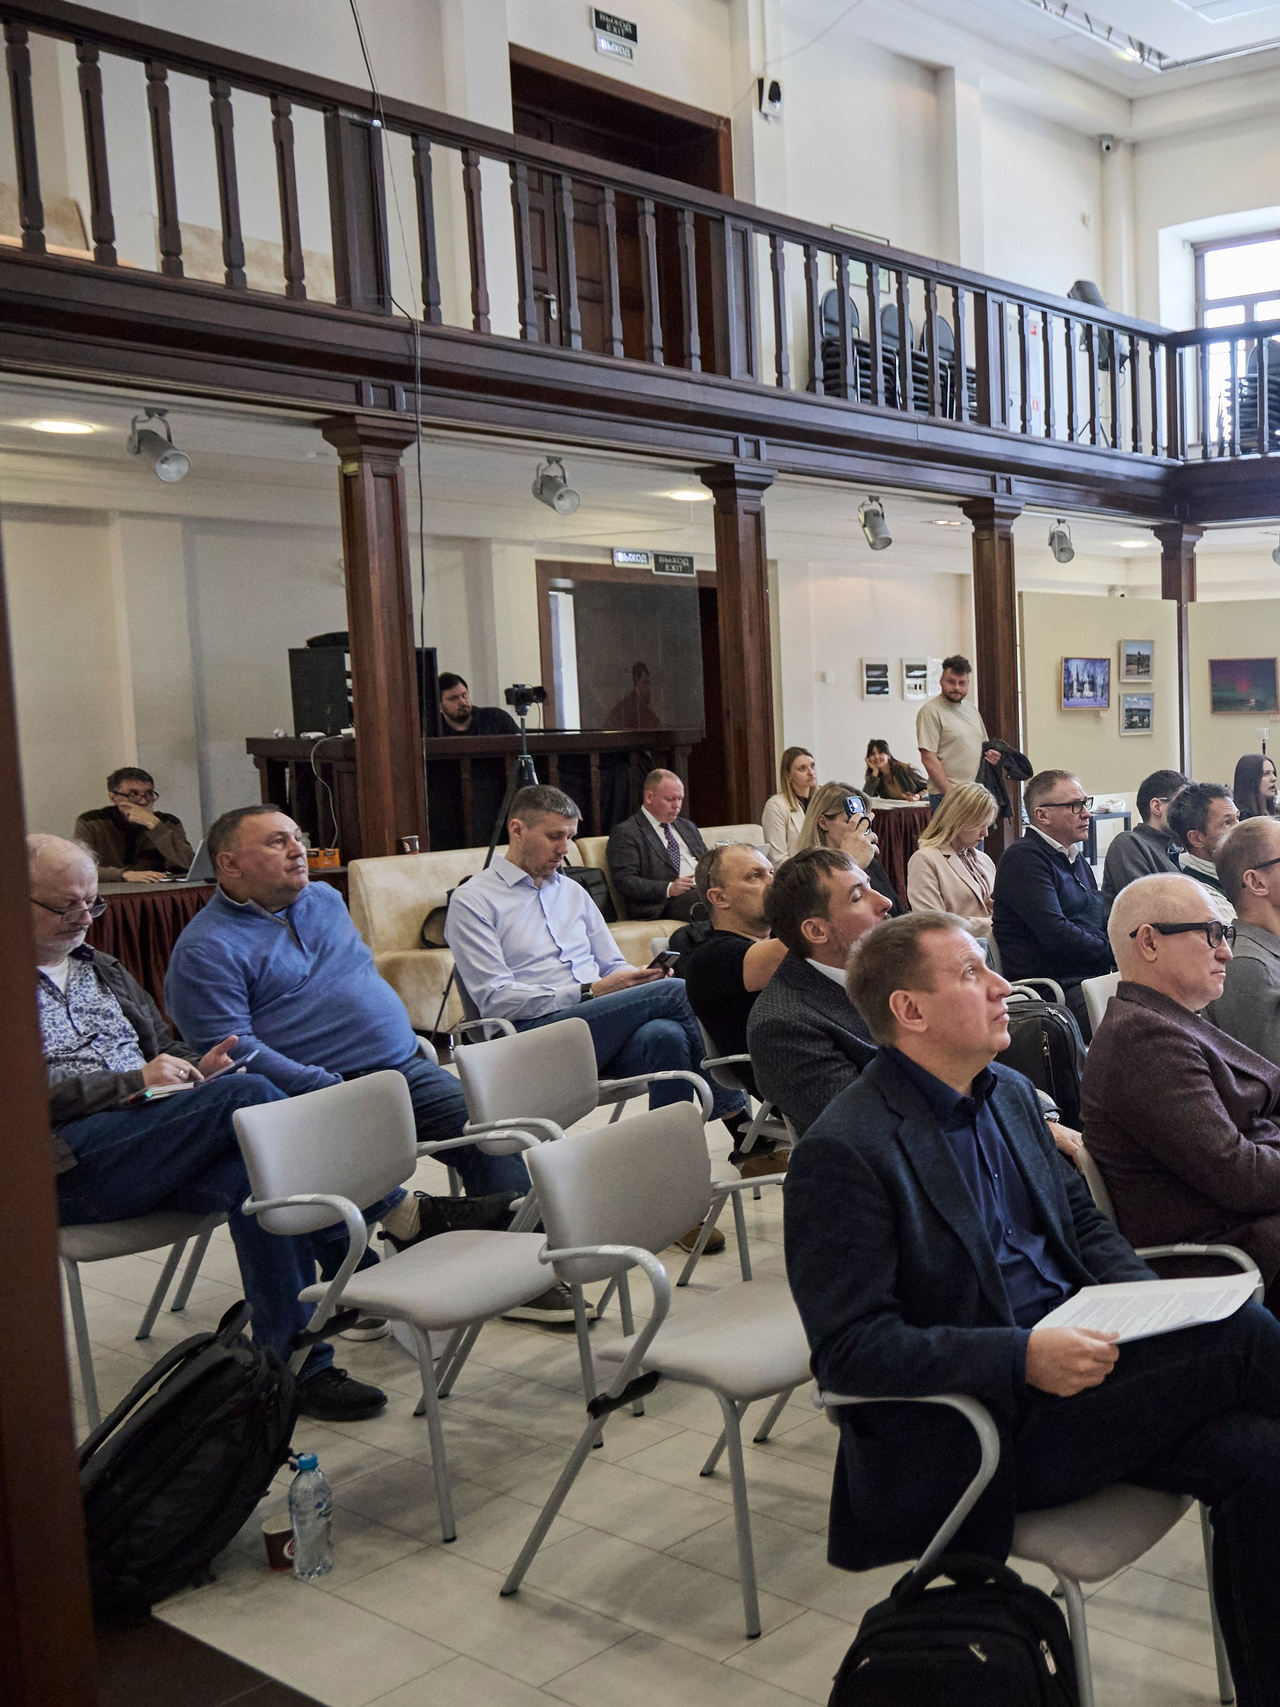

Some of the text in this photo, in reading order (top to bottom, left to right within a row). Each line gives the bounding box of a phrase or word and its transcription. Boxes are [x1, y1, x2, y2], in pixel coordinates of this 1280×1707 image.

[599, 13, 632, 34] ВЫХОД
[606, 24, 625, 37] EXIT
[600, 38, 630, 58] ВЫХОД
[617, 552, 647, 564] ВЫХОД
[658, 556, 690, 567] ВЫХОД
[665, 564, 683, 572] EXIT
